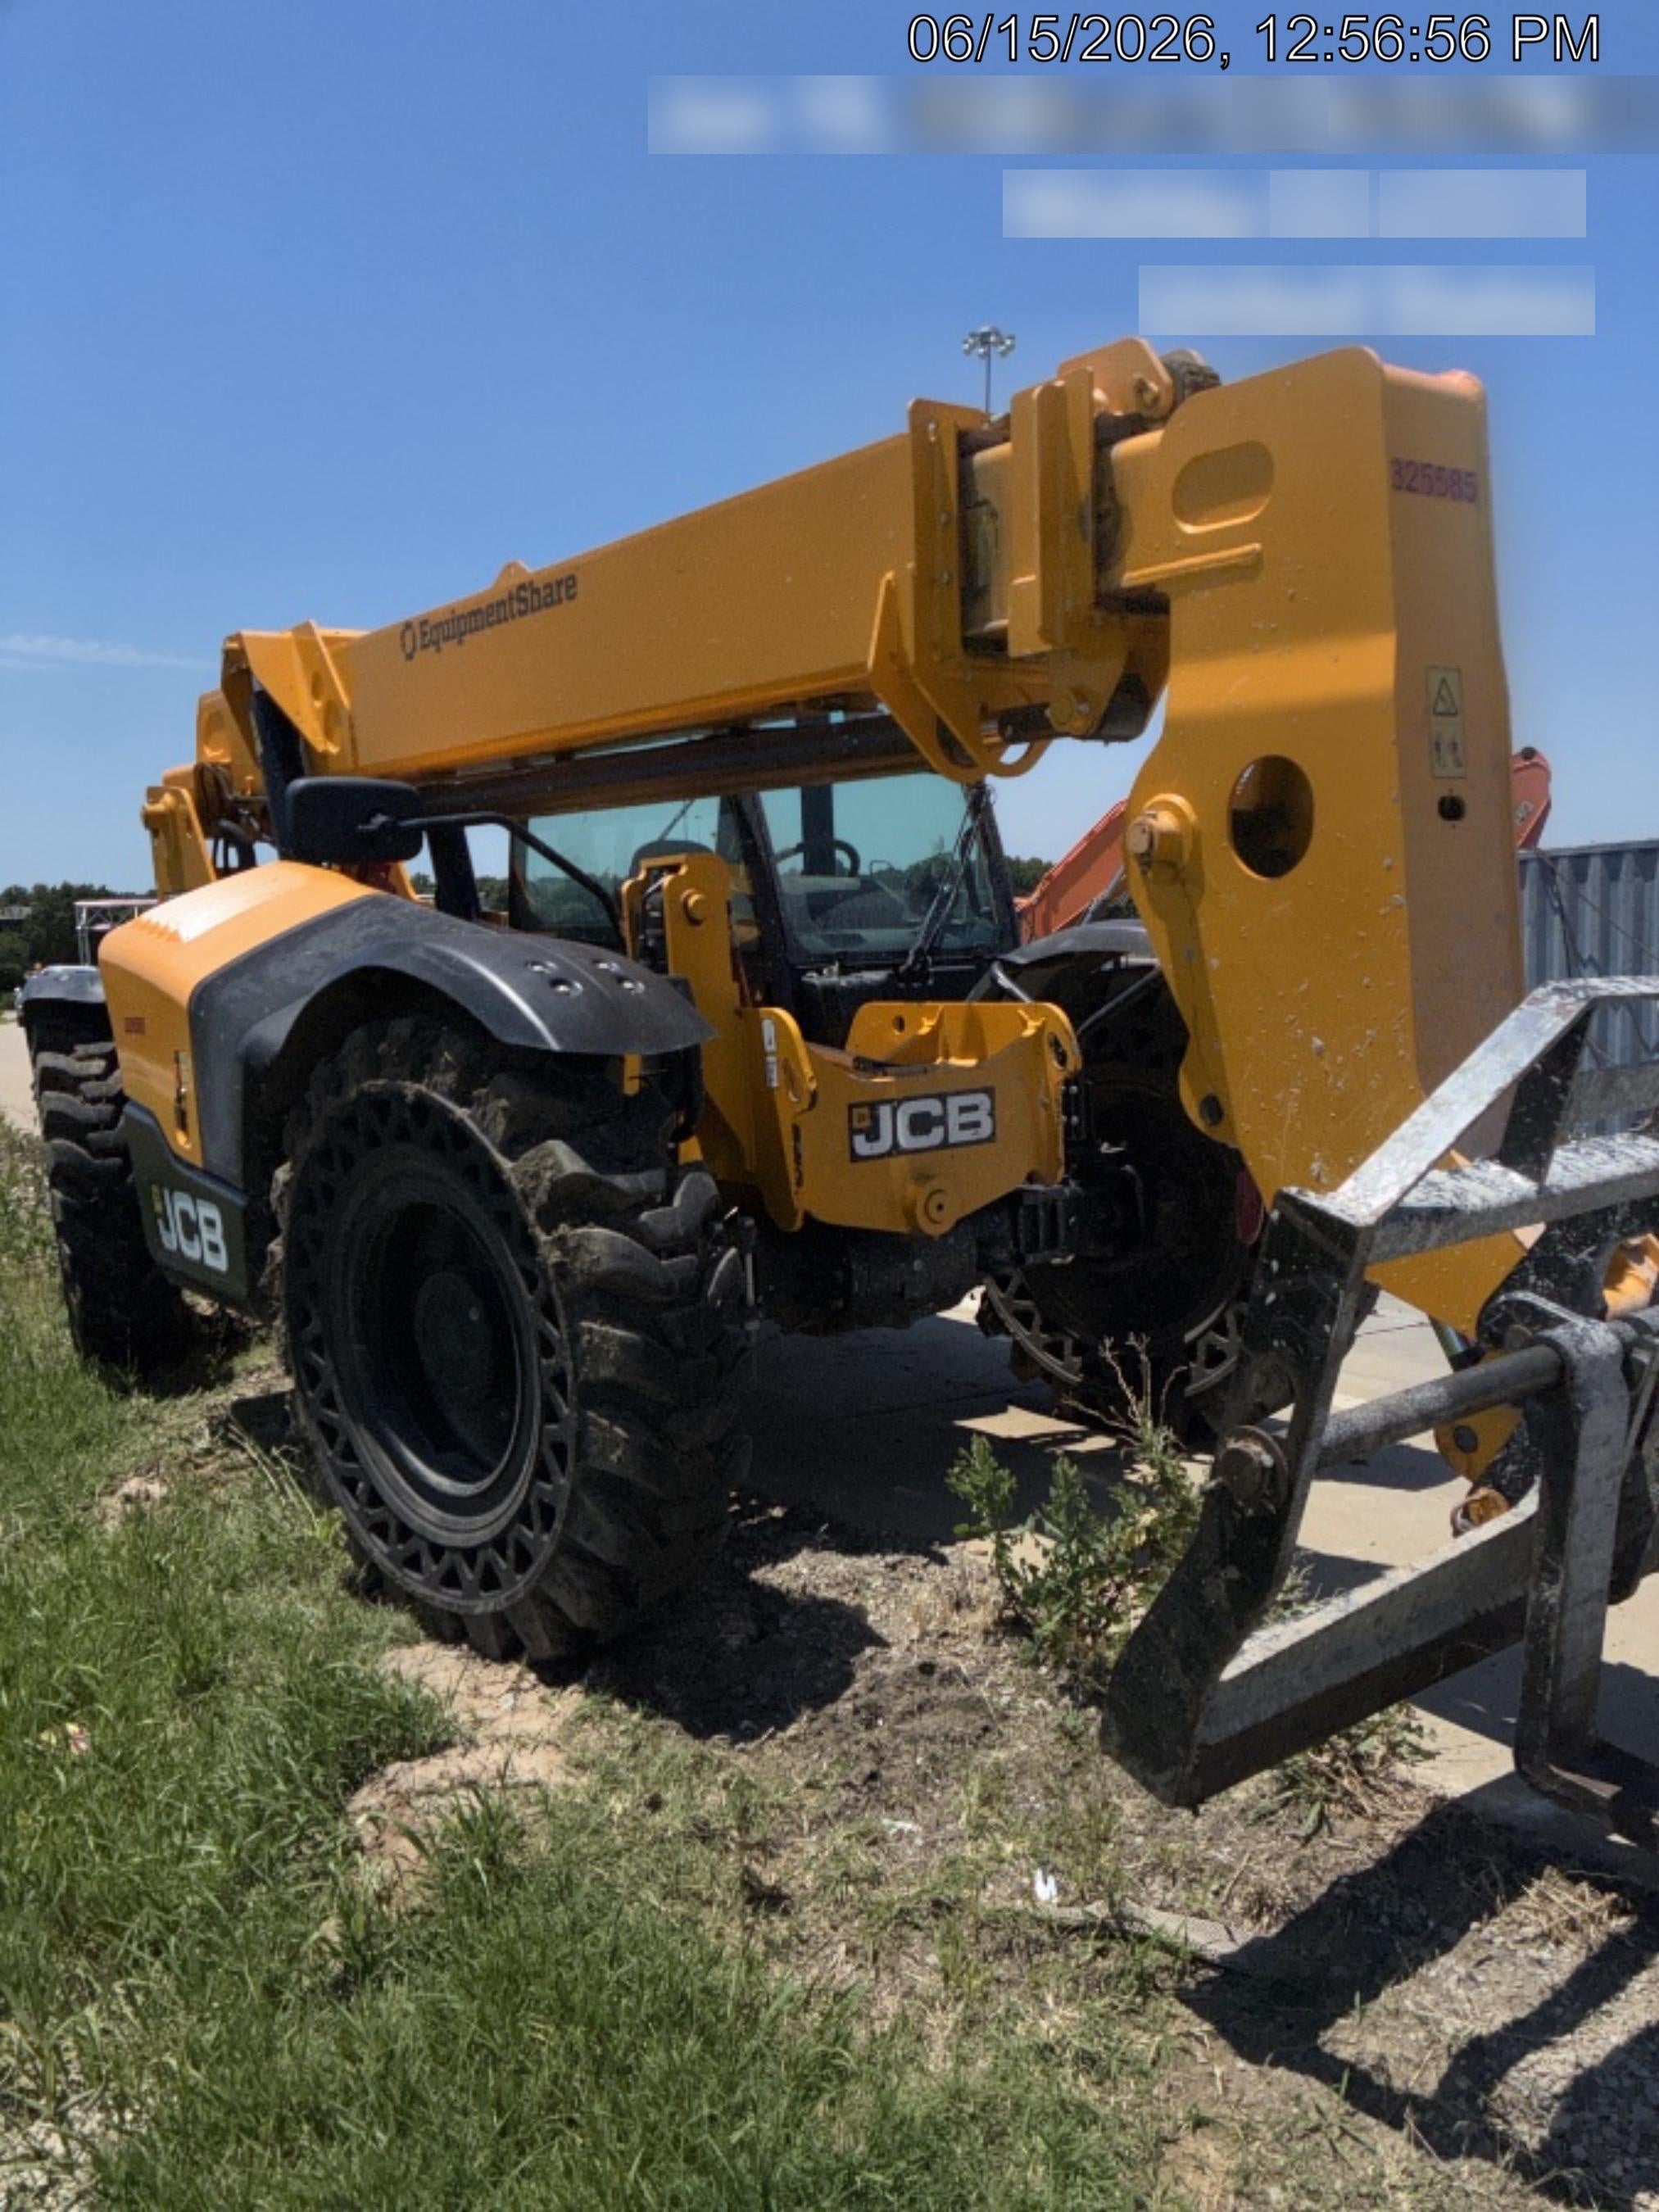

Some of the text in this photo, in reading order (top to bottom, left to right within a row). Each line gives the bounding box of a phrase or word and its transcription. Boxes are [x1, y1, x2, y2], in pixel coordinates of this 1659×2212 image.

[419, 573, 578, 652] EquipmentShare
[851, 1092, 995, 1157] JCB
[156, 1187, 229, 1272] JCB
